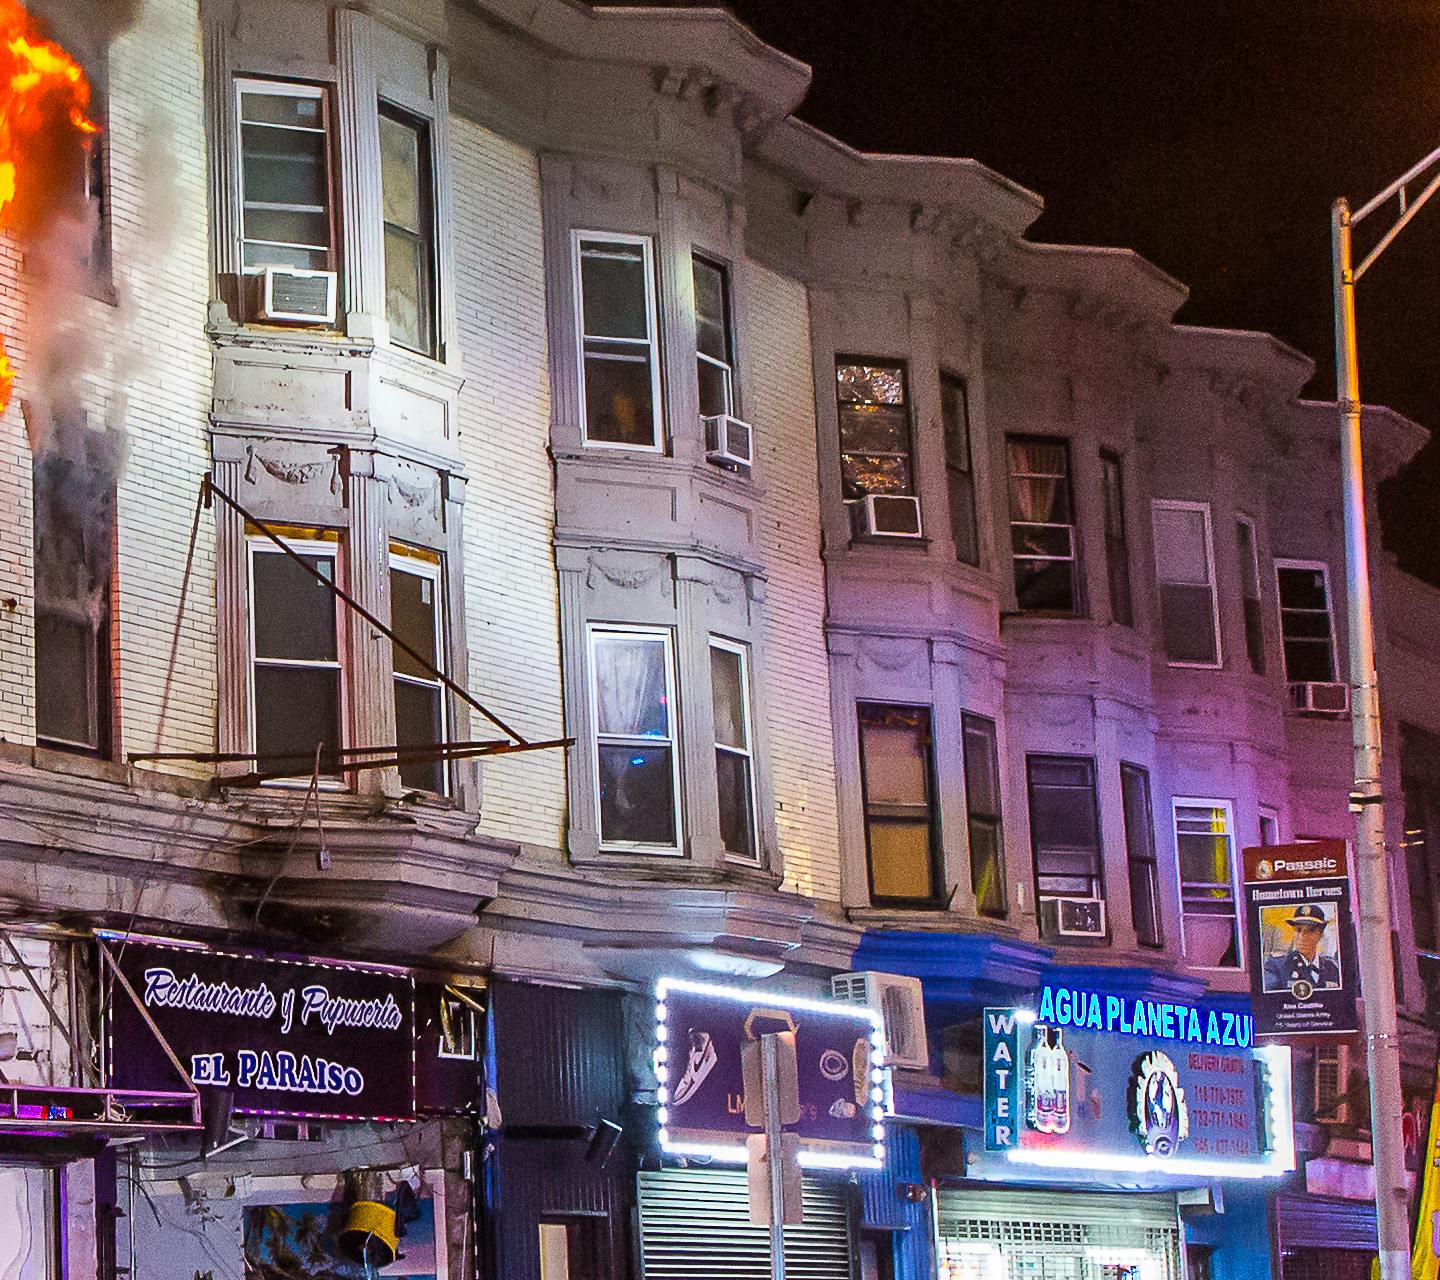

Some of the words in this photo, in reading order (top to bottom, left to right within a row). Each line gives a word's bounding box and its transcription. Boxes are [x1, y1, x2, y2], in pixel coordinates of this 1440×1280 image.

[1274, 857, 1337, 872] Passaic
[1252, 888, 1304, 901] Hometown
[1306, 886, 1343, 898] Heroes
[145, 968, 277, 1019] Restaurante
[281, 988, 296, 1034] y
[1039, 986, 1103, 1030] AGUA
[1107, 996, 1204, 1044] PLANETA
[1206, 1010, 1255, 1048] AZU
[192, 1053, 230, 1086] EL
[237, 1050, 364, 1095] PARAISO
[988, 1014, 1016, 1146] WATER
